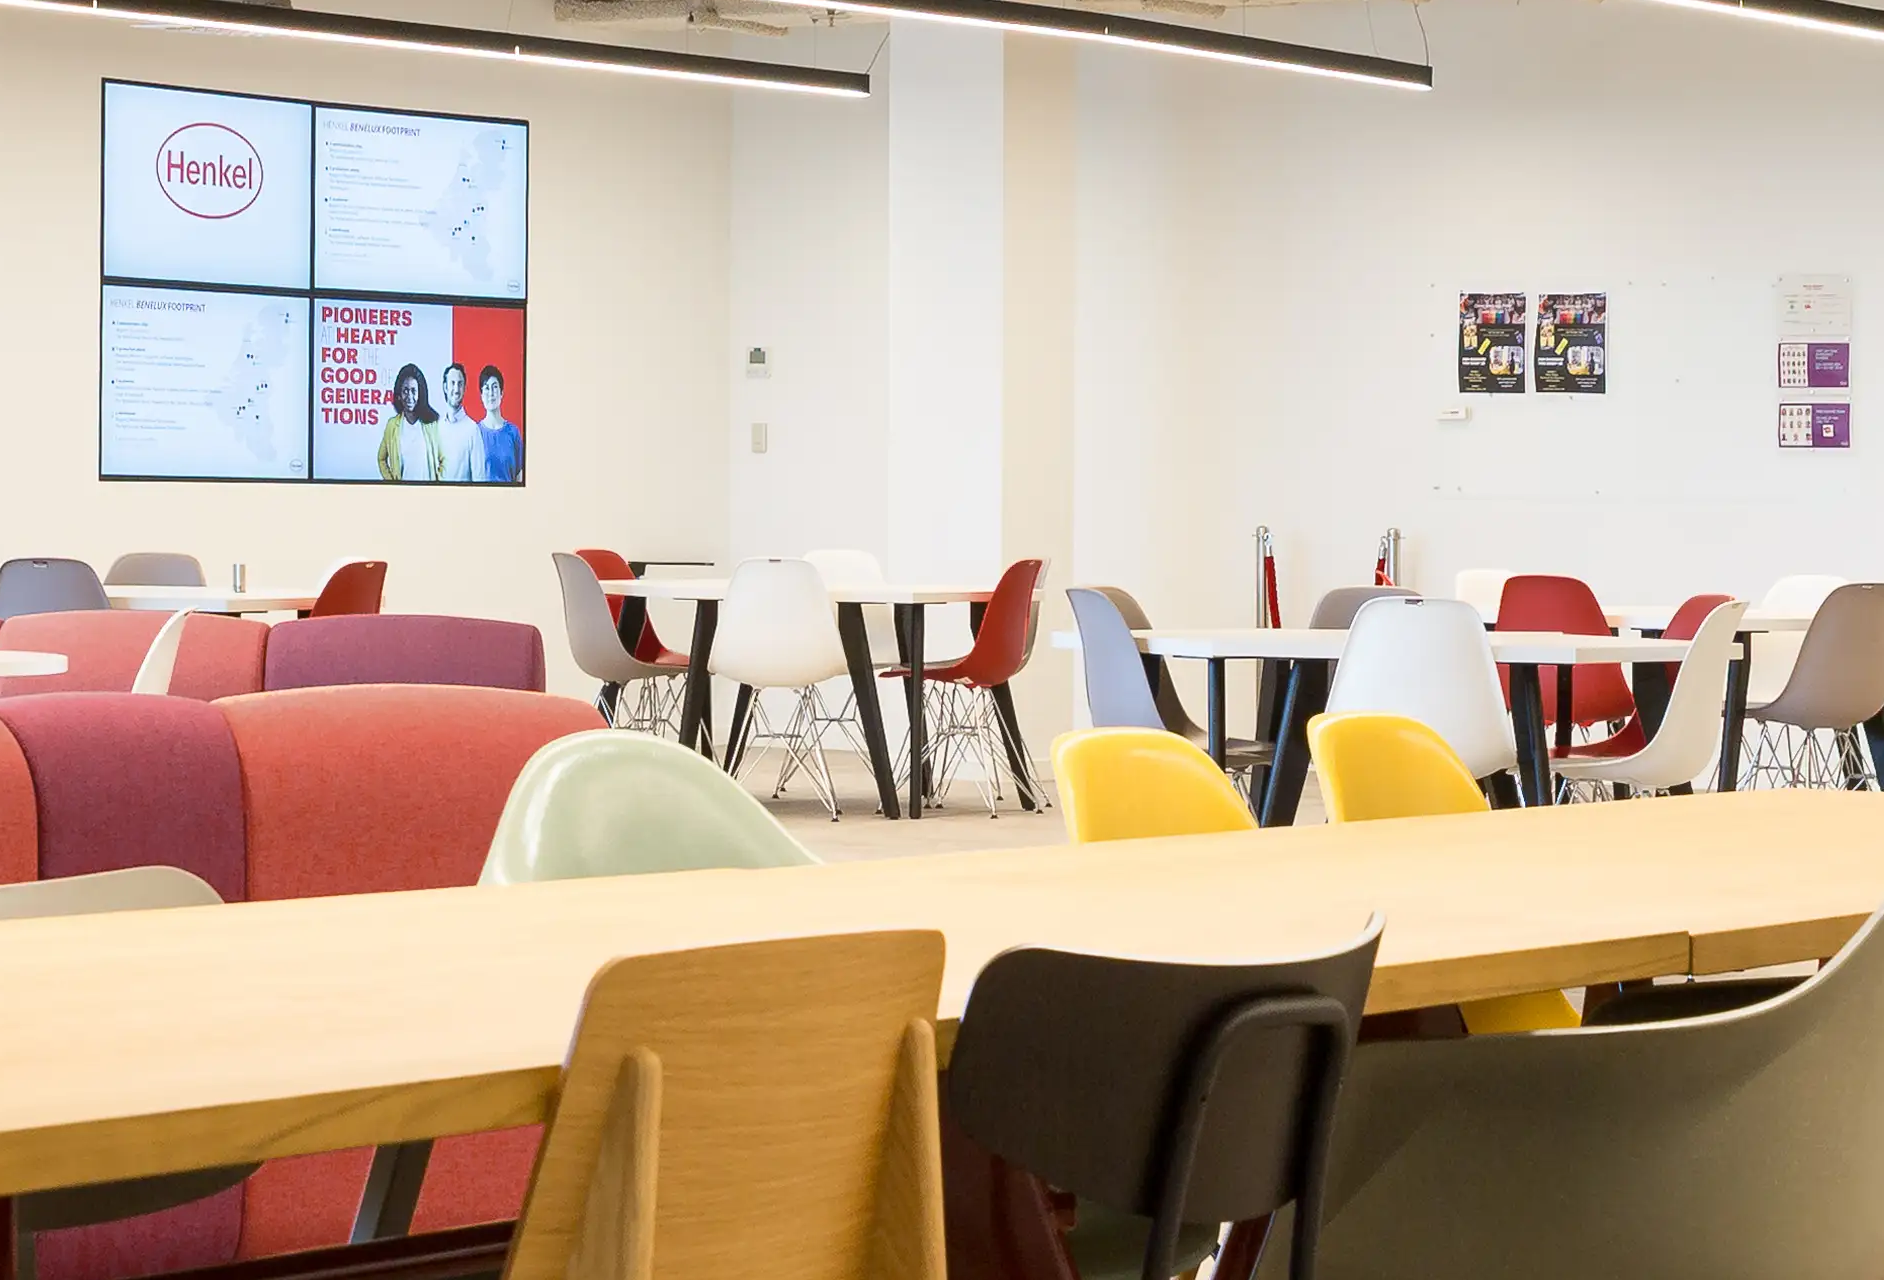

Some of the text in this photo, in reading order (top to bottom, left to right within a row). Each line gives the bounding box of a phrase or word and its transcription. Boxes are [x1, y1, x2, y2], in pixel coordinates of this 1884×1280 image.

[350, 122, 381, 133] BENELUX
[382, 125, 421, 136] FOOTPRINT
[167, 150, 252, 189] Henkel
[136, 300, 167, 310] BENELUX
[167, 302, 206, 312] FOOTPRINT
[321, 306, 412, 327] PIONEERS
[321, 326, 398, 345] AT HEART
[321, 347, 358, 364] FOR
[320, 367, 377, 384] GOOD
[320, 387, 394, 405] GENERA
[321, 407, 379, 425] TIONS
